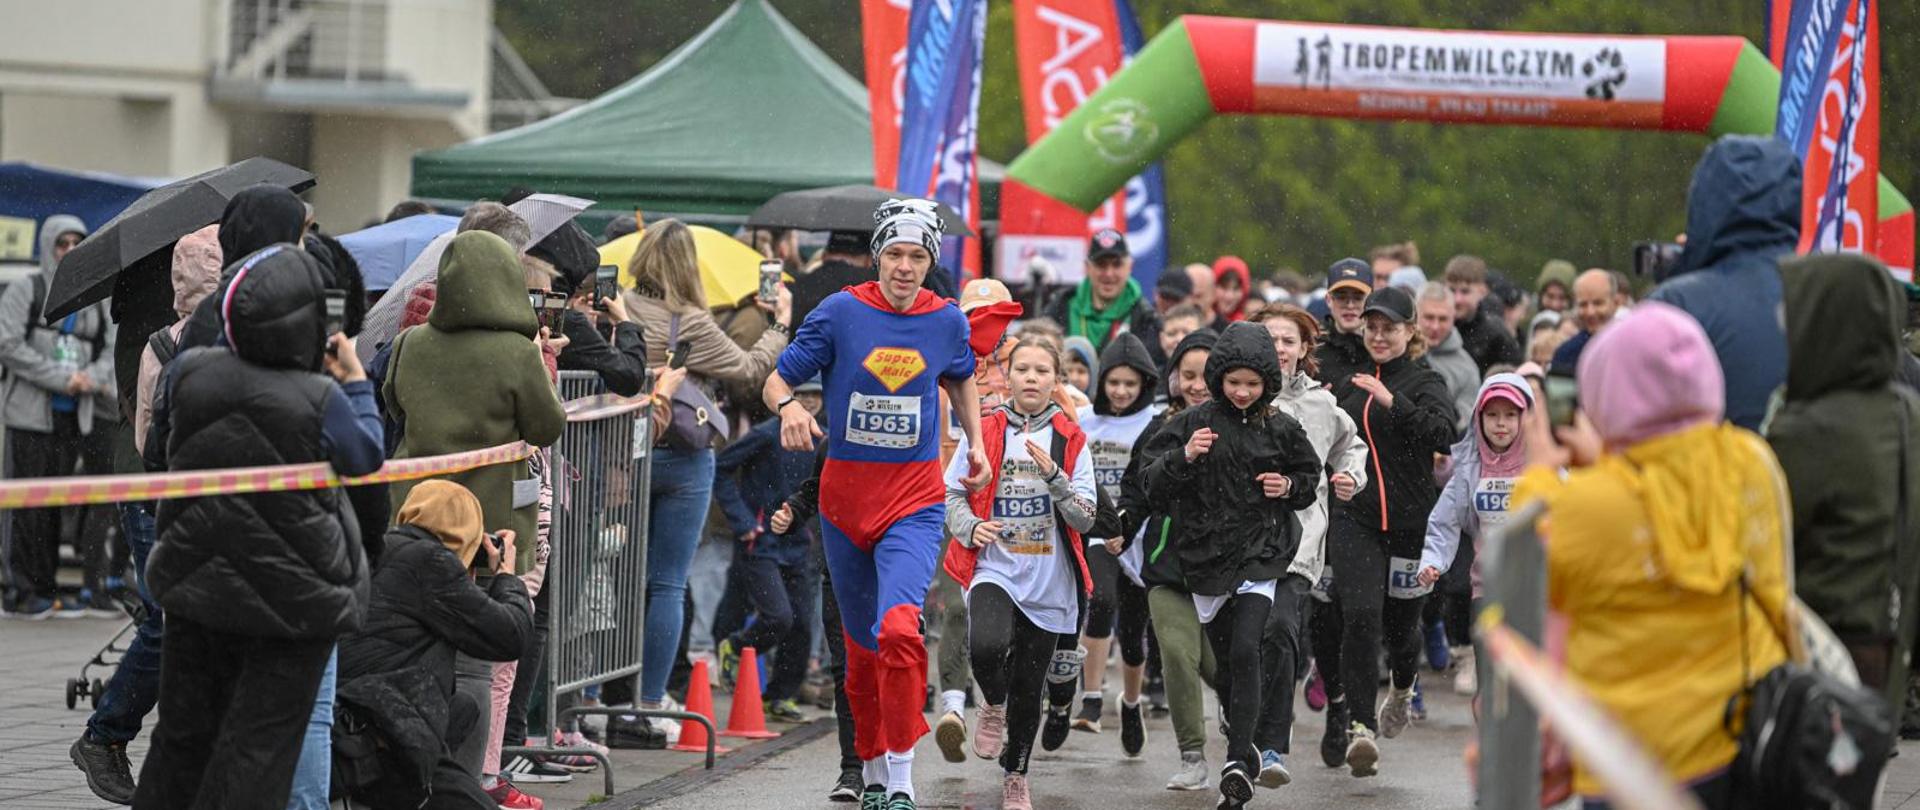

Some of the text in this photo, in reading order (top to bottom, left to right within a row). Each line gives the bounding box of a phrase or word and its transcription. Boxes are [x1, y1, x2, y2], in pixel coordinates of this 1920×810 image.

[875, 352, 918, 365] Super
[880, 366, 912, 378] Male
[857, 413, 910, 433] 1963
[998, 498, 1045, 516] 1963
[1481, 494, 1511, 510] 196
